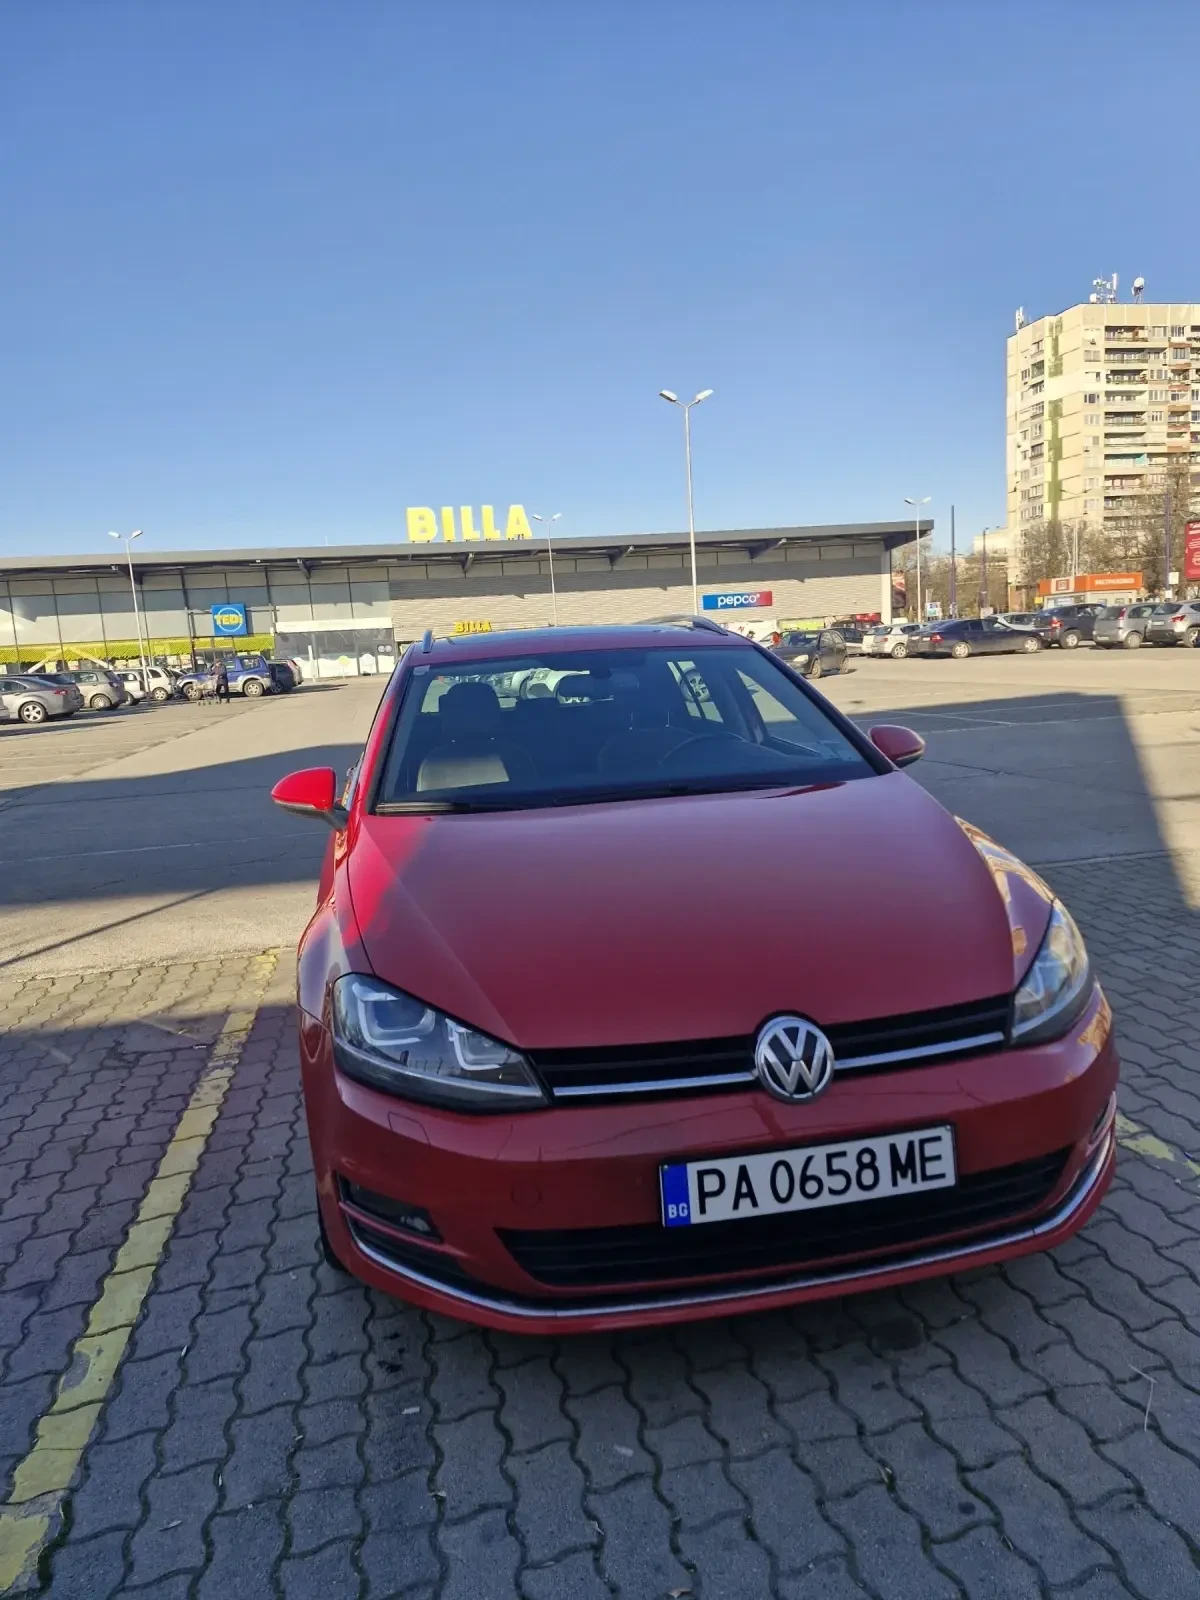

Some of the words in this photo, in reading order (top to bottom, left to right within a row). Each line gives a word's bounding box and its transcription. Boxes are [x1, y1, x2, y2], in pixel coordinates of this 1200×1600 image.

[406, 504, 533, 542] BILLA
[717, 595, 757, 608] pepco
[454, 620, 492, 633] BILLA
[696, 1163, 759, 1215] PA
[770, 1146, 880, 1204] 0658
[889, 1135, 947, 1188] ME
[667, 1202, 689, 1219] BG
